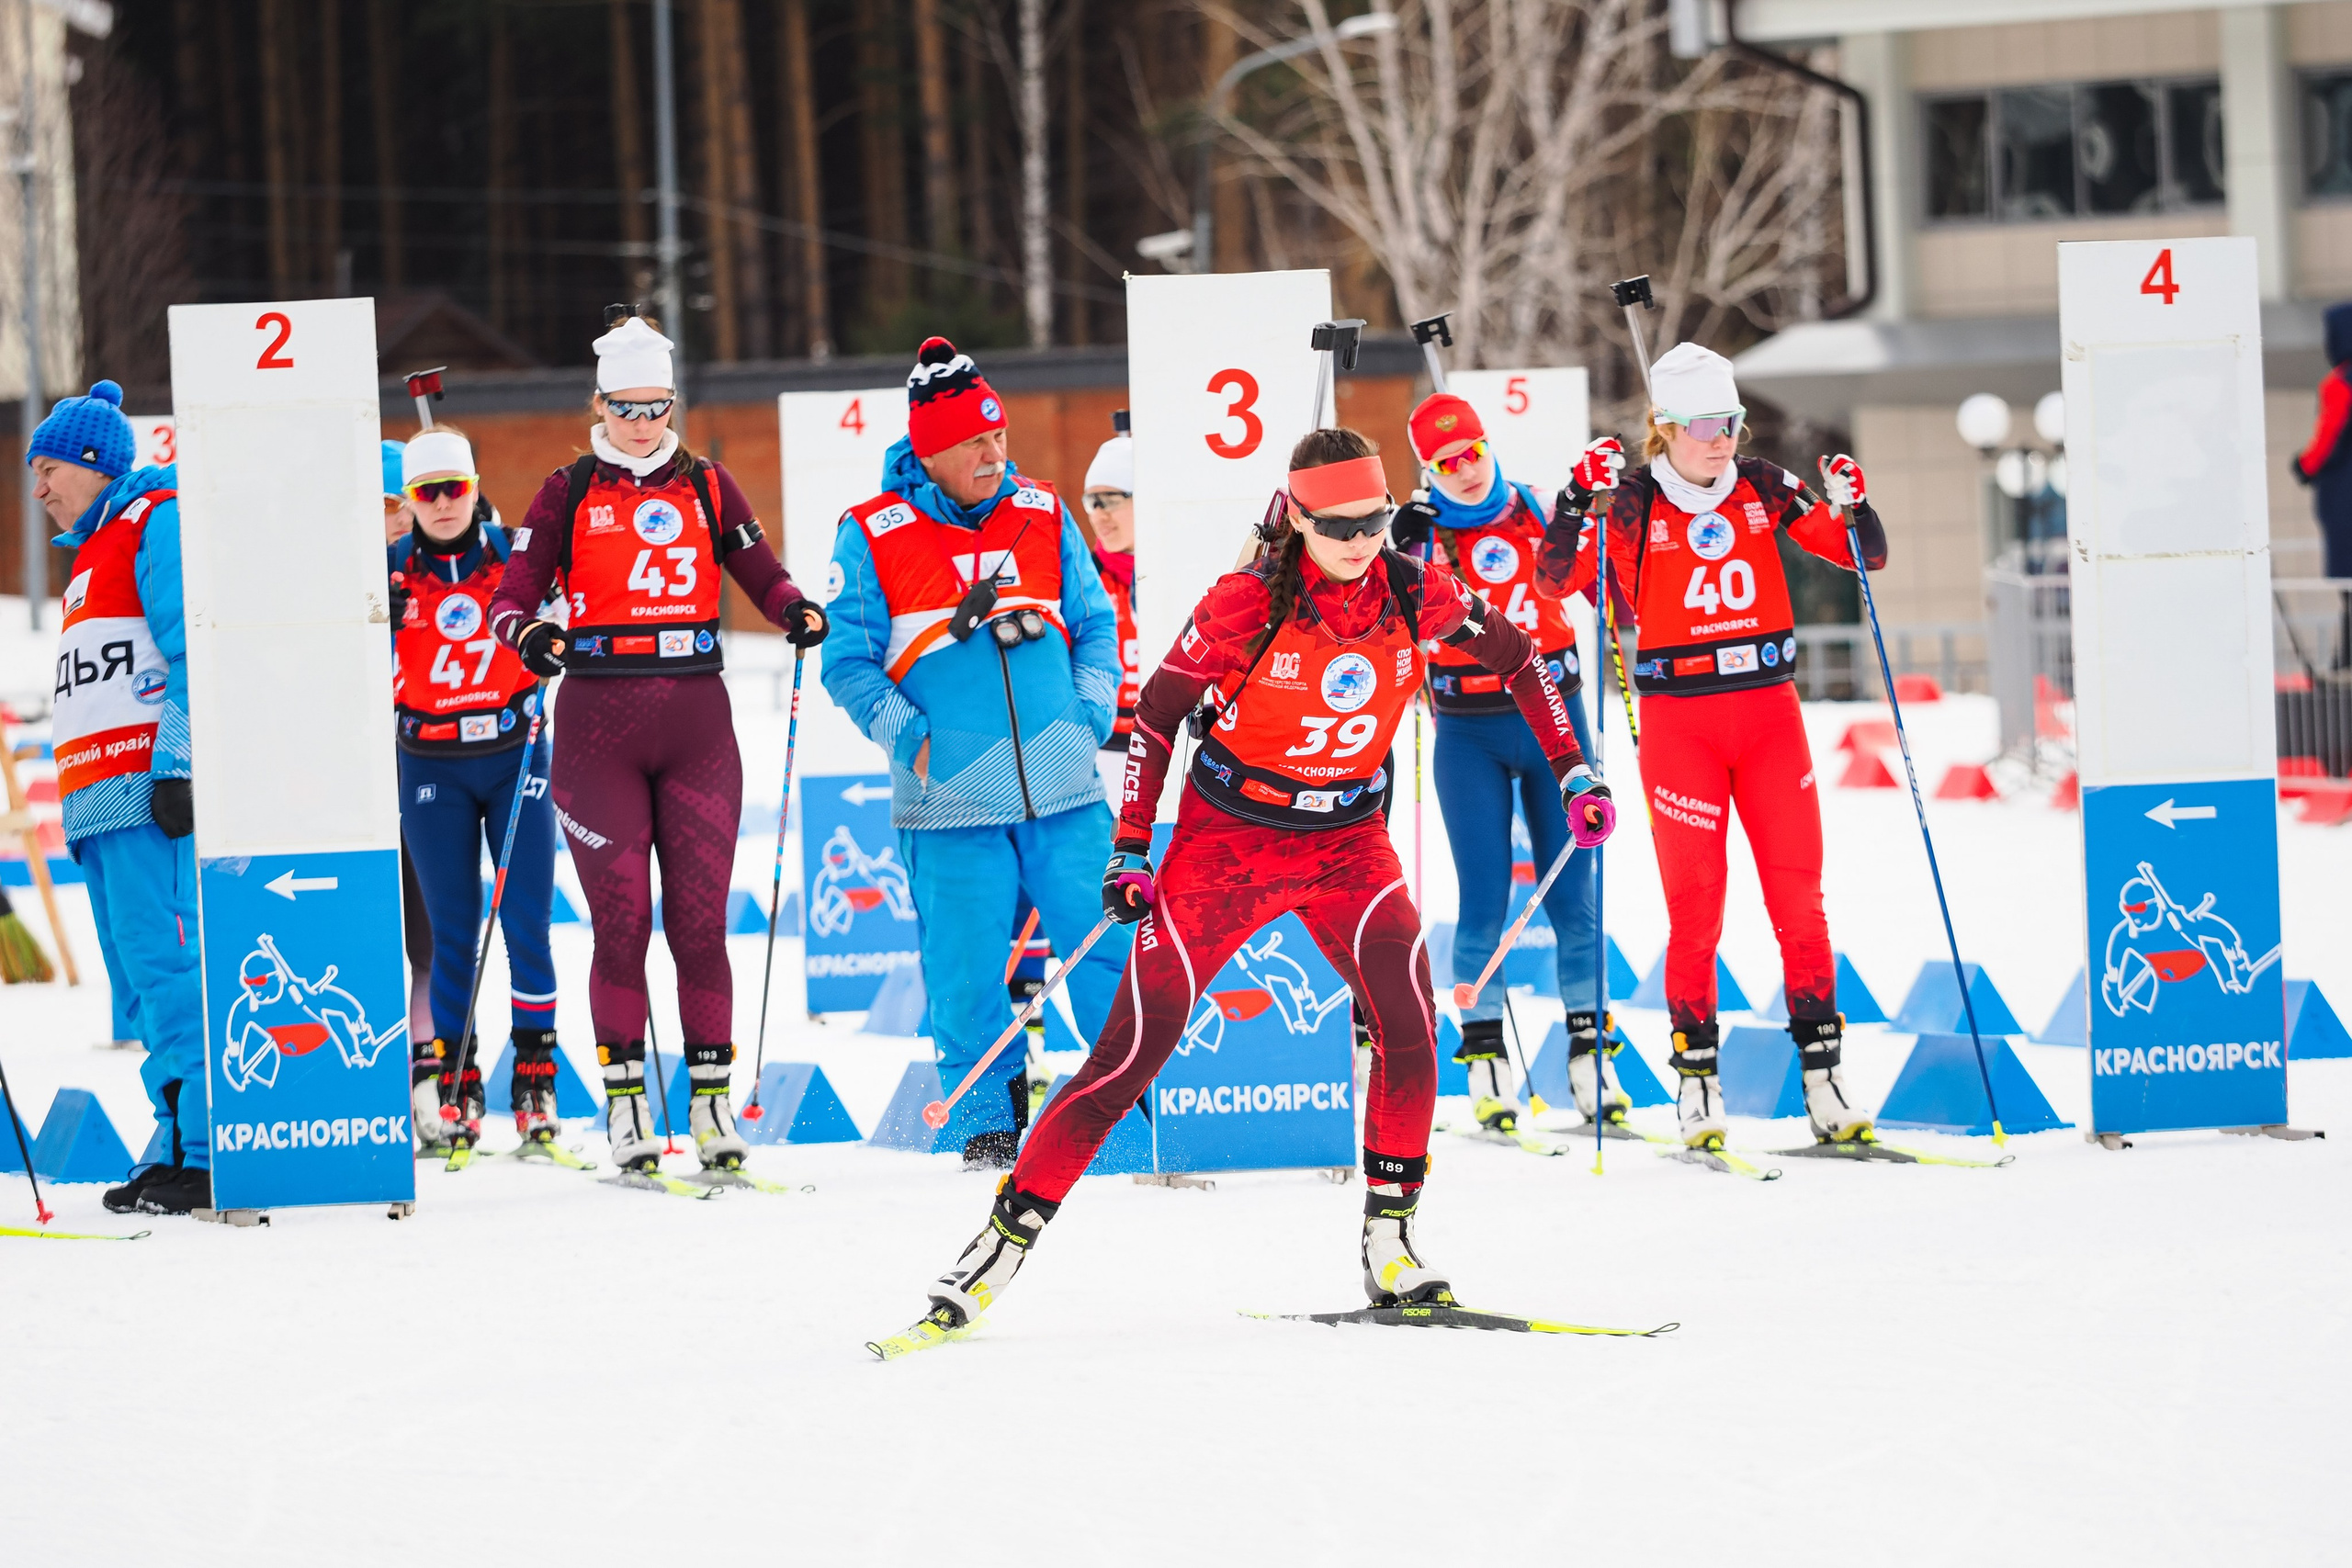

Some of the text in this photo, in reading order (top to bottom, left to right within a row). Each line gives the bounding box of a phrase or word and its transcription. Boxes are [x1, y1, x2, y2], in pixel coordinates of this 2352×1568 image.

[2140, 248, 2179, 305] 4
[254, 311, 294, 369] 2
[1204, 367, 1263, 459] 3
[1504, 377, 1531, 415] 5
[839, 398, 866, 435] 4
[153, 424, 176, 465] 3
[876, 507, 904, 529] 35
[628, 547, 697, 597] 43
[1684, 558, 1756, 615] 40
[570, 592, 586, 618] 3
[631, 604, 697, 617] КРАСНОЯРСК
[1690, 617, 1759, 637] КРАСНОЯРСК
[54, 639, 134, 705] ДЬЯ
[429, 638, 497, 690] 47
[435, 690, 501, 709] КРАСНОЯРСК
[1532, 654, 1569, 737] УДМУРТИЯ
[105, 732, 151, 759] край
[1284, 715, 1378, 759] 39
[1654, 785, 1722, 818] АКАДЕМИЯ
[1816, 1023, 1836, 1035] 190
[696, 1050, 717, 1061] 193
[2095, 1040, 2282, 1077] КРАСНОЯРСК
[1159, 1082, 1350, 1115] КРАСНОЯРСК
[216, 1115, 408, 1152] КРАСНОЯРСК
[1378, 1160, 1404, 1173] 189
[991, 1214, 1028, 1246] FISCHER
[1402, 1308, 1430, 1316] FISCHER
